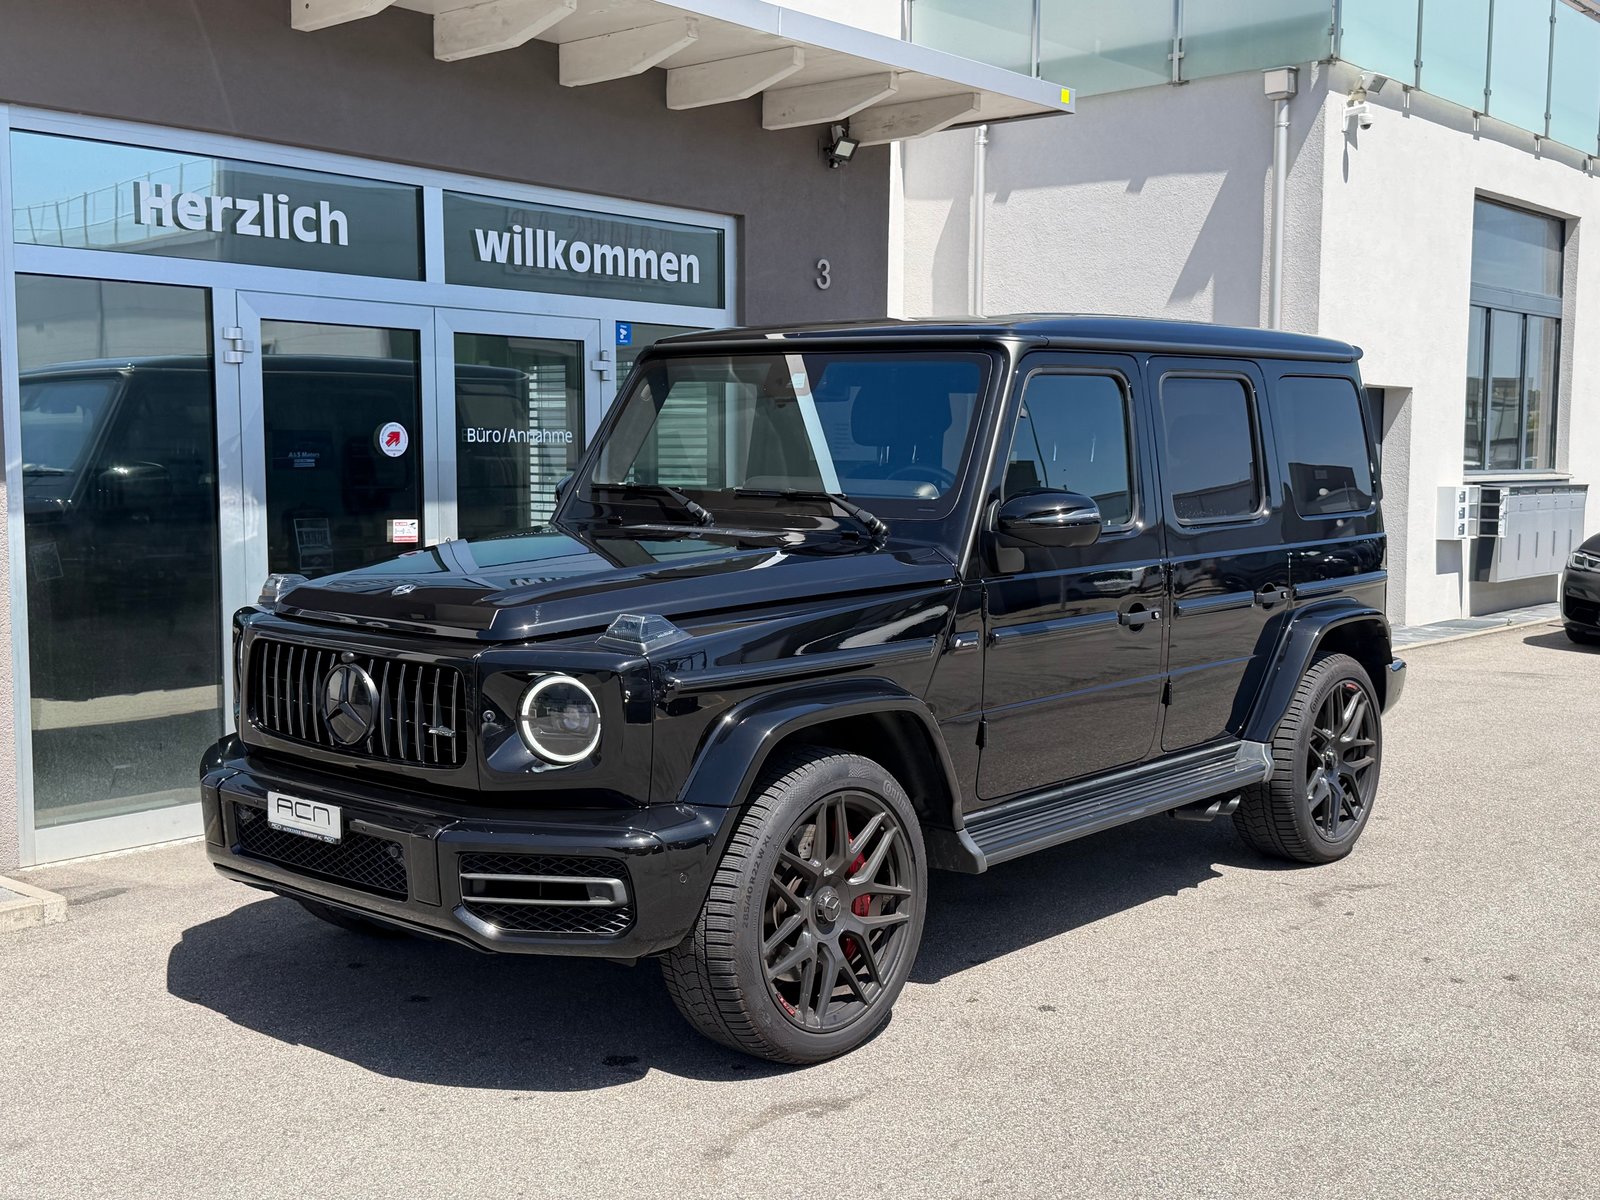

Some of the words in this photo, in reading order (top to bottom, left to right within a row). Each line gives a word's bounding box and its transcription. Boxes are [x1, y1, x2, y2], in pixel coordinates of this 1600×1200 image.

[139, 180, 349, 246] Herzlich
[474, 224, 700, 284] willkommen
[816, 258, 831, 290] 3
